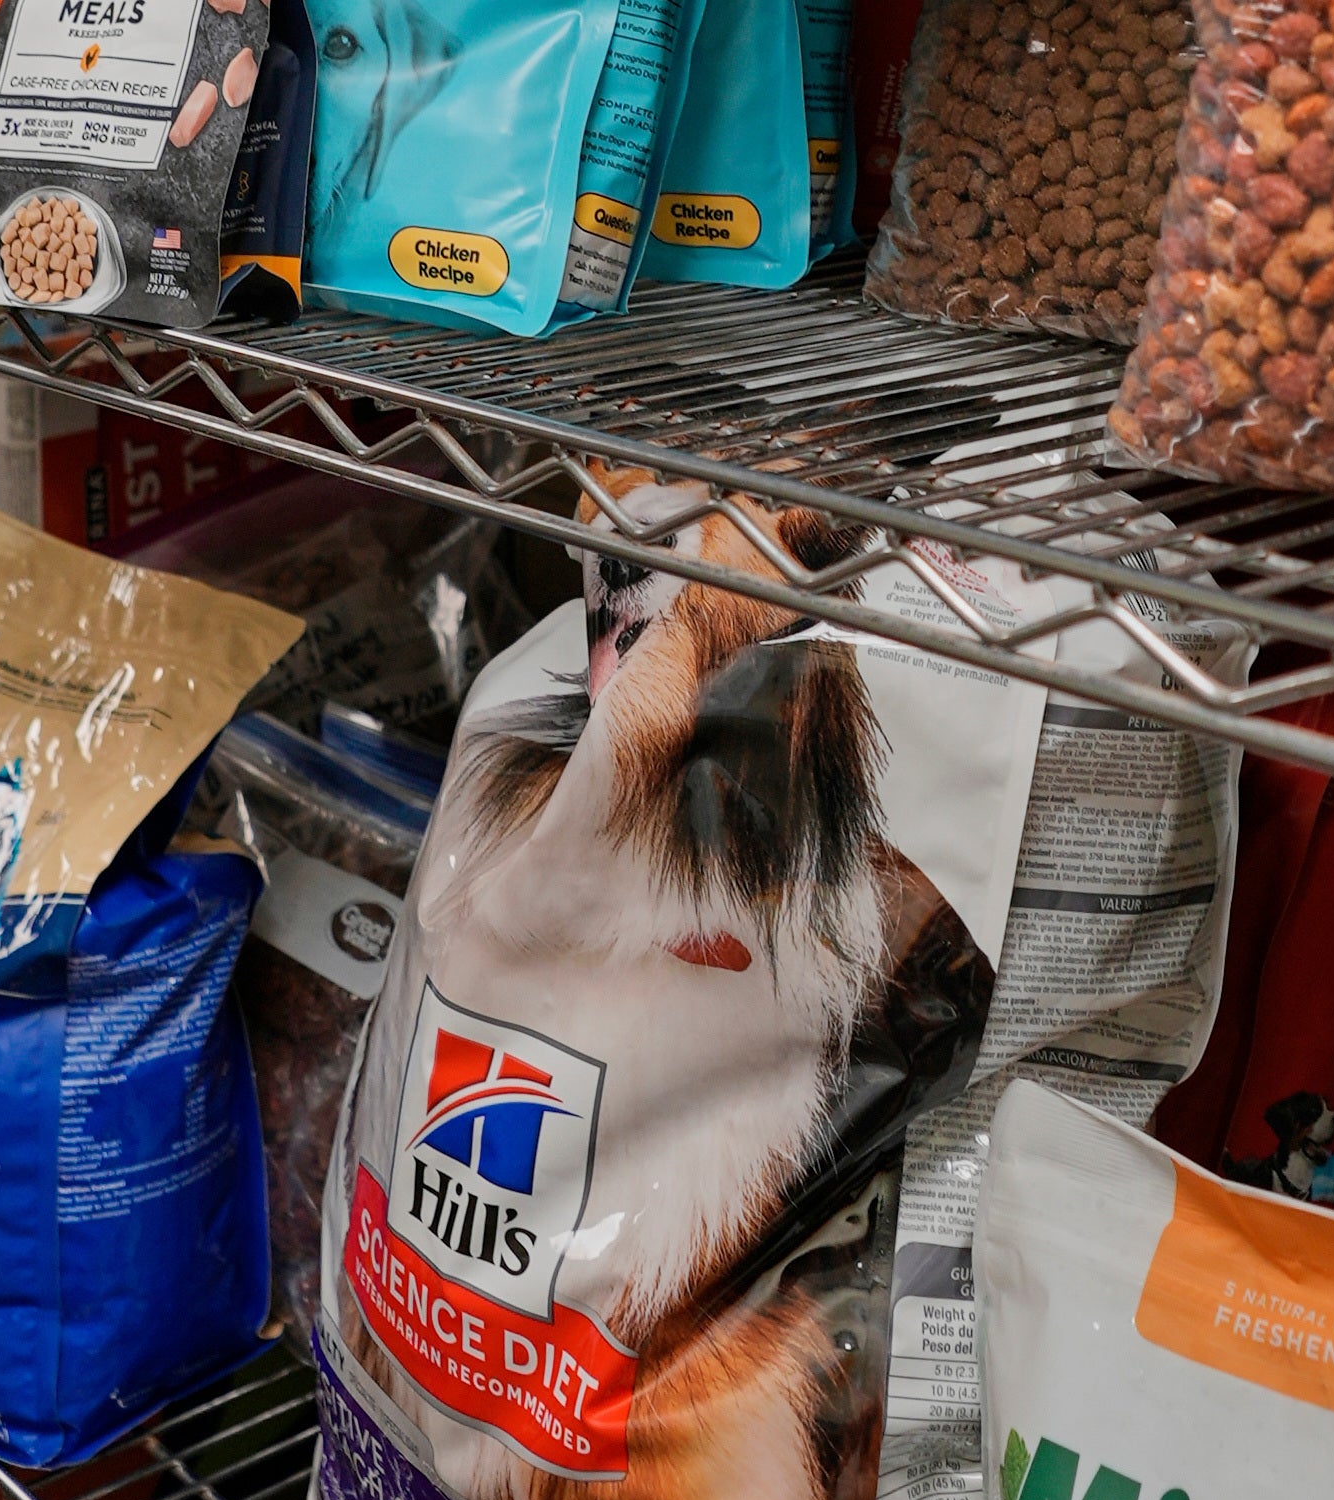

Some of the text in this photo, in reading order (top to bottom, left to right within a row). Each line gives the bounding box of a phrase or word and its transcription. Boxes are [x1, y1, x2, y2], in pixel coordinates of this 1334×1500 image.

[68, 29, 124, 39] FREEZE-DRIED
[614, 63, 642, 76] AAFCO
[10, 76, 168, 98] CAGE-FREE CHICKEN RECIPE
[597, 98, 653, 120] COMPLETE
[875, 63, 897, 139] HEALTHY
[0, 117, 21, 136] 3x
[84, 121, 111, 133] NON
[614, 113, 635, 127] FOR
[81, 131, 108, 144] GMO
[670, 203, 734, 222] Chicken
[675, 223, 730, 241] Recipe
[414, 238, 480, 264] Chicken
[418, 260, 474, 286] Recipe
[893, 580, 917, 594] Nous
[885, 591, 932, 610] d'animaux
[913, 608, 938, 625] foyer
[938, 612, 960, 629] pour
[867, 645, 1010, 690] encontrar un hogar permanente
[1099, 897, 1143, 912] VALEUR
[409, 1155, 537, 1276] Hill's
[899, 1201, 943, 1214] Declaración
[357, 1207, 599, 1421] SCIENCE DIET
[923, 1304, 965, 1322] Weight
[1243, 1287, 1328, 1330] NATURAL
[922, 1322, 974, 1338] Poids du
[354, 1255, 442, 1369] VETERINARIAN
[446, 1356, 591, 1455] RECOMMENDED
[922, 1339, 973, 1354] Peso del
